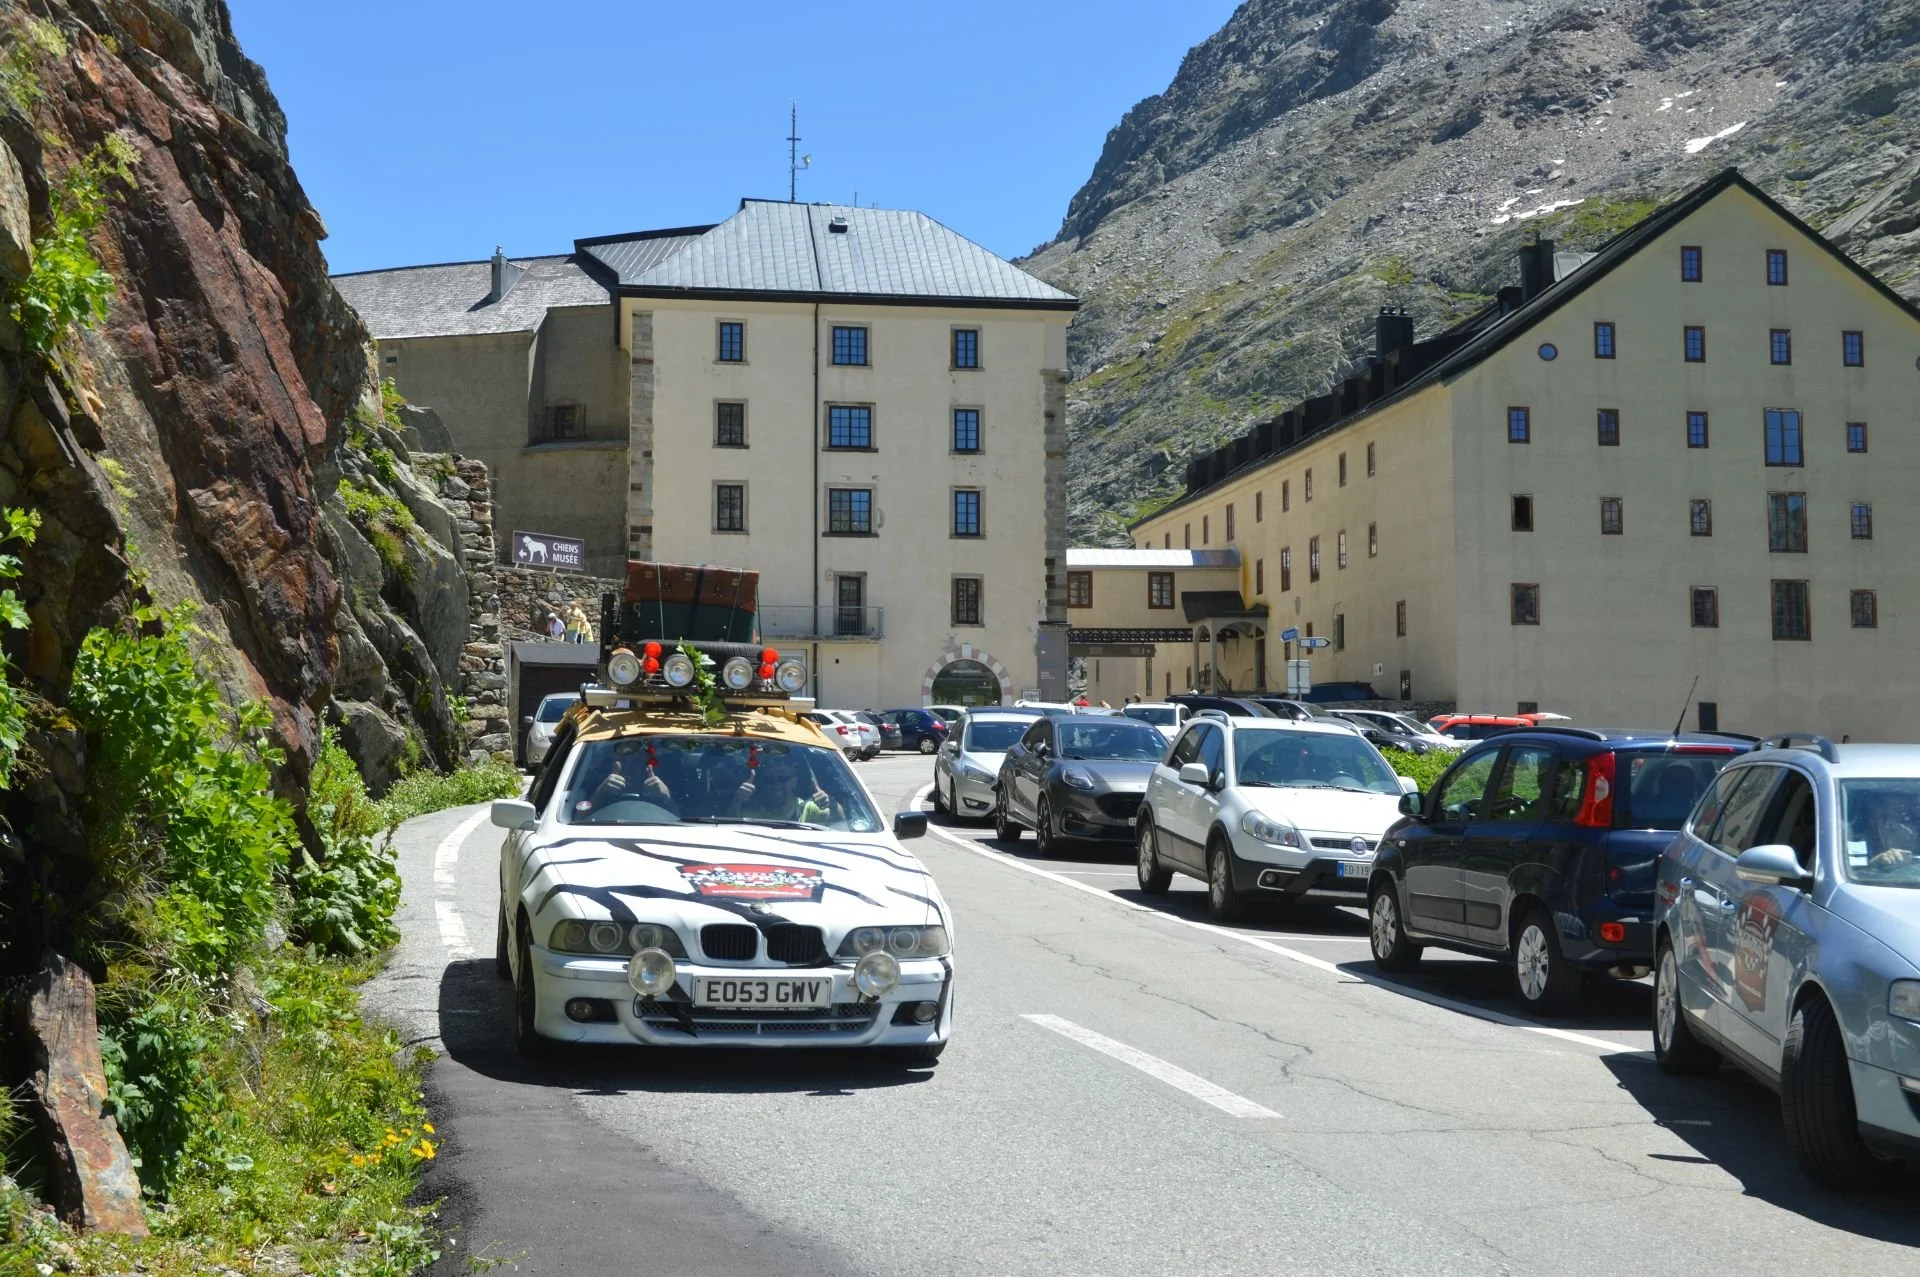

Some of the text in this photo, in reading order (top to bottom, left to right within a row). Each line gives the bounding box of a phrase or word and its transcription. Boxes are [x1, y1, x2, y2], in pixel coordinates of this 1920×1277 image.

[552, 542, 579, 554] CHIENS
[552, 553, 579, 565] MUSÉE
[706, 981, 820, 1003] EO53 GWV
